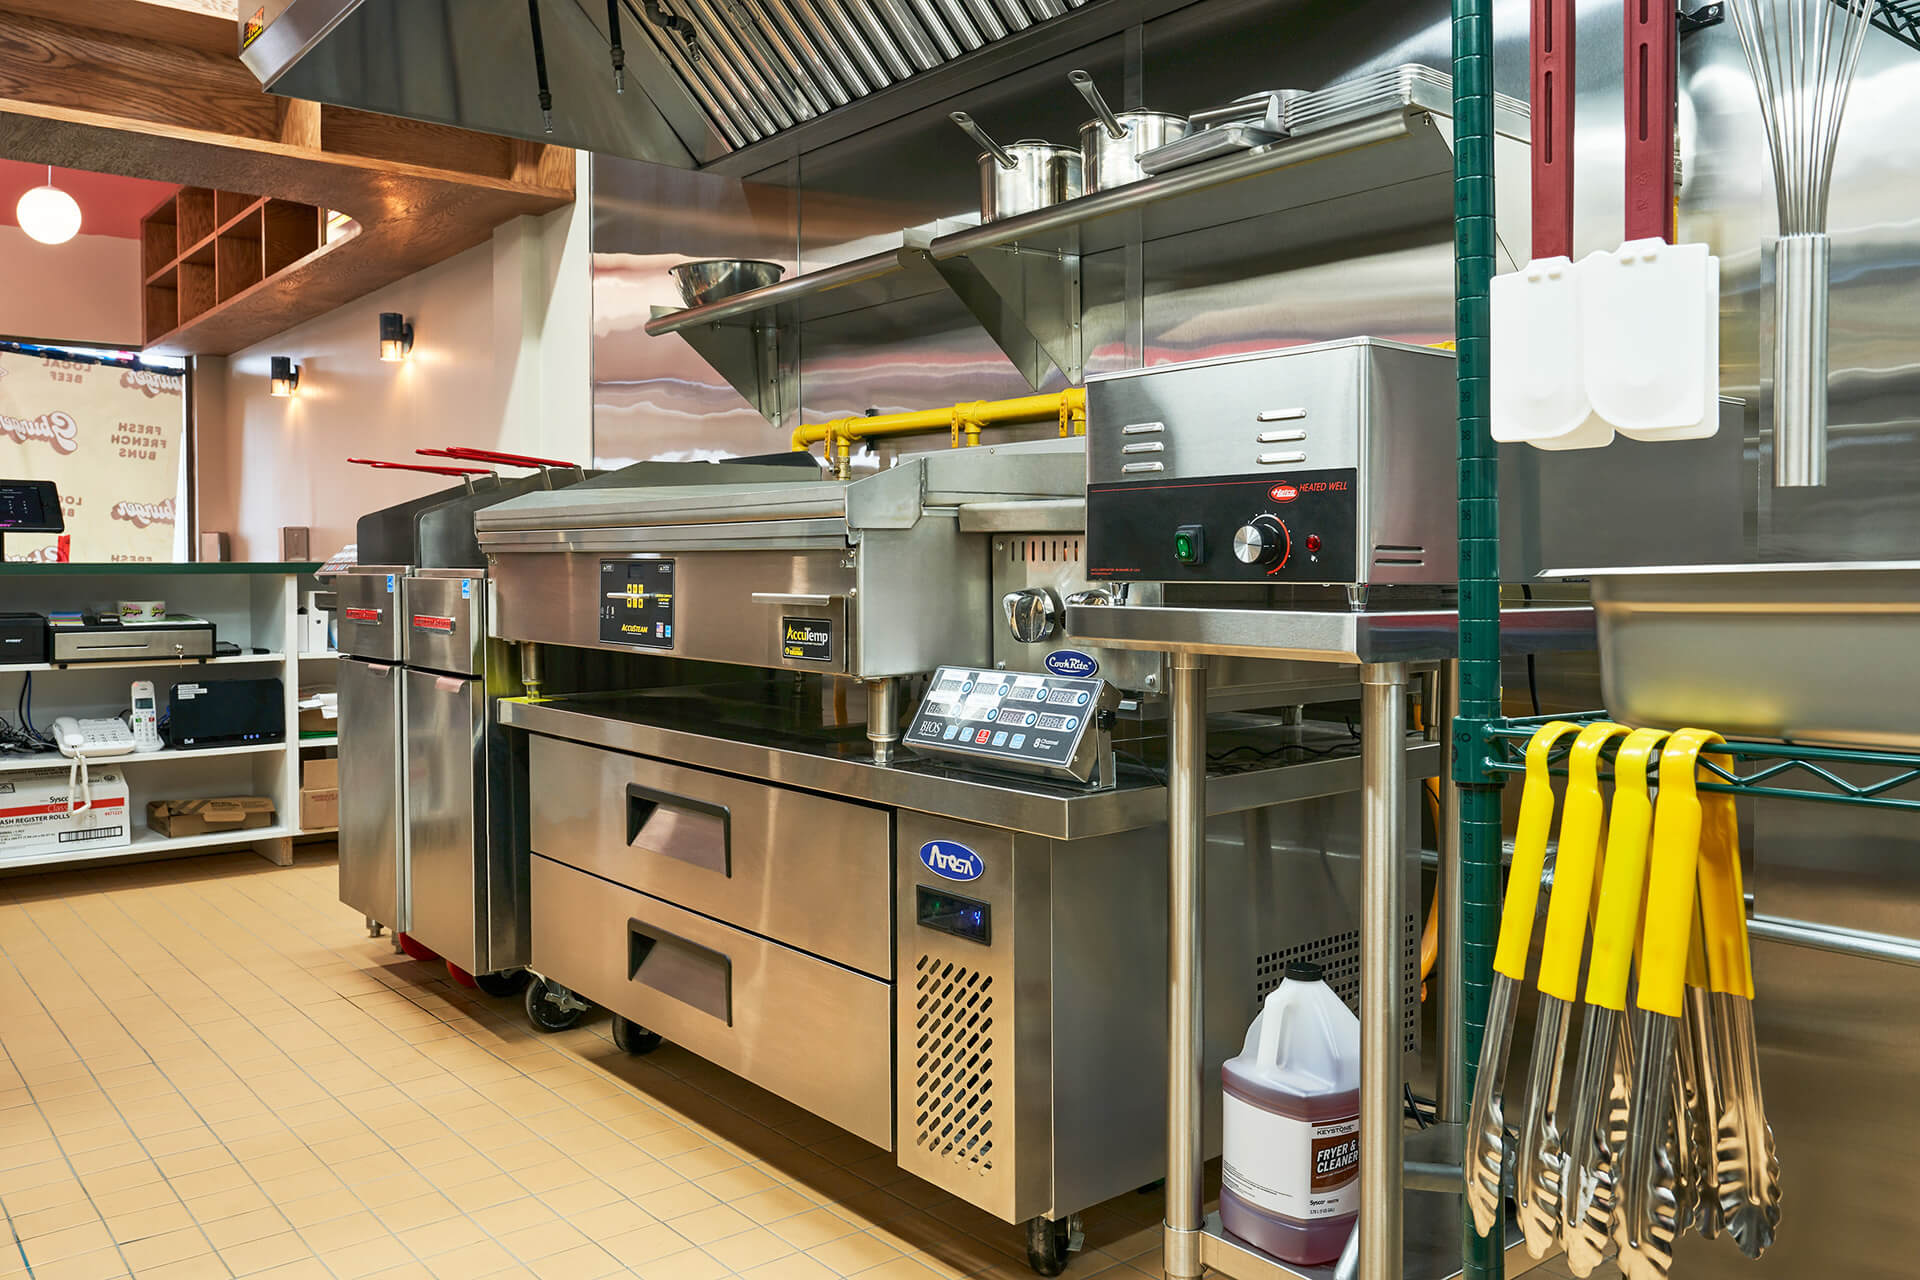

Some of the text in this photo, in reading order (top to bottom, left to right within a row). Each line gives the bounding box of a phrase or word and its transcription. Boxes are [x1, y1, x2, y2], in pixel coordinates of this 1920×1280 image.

[1299, 481, 1348, 492] HEATED WELL
[786, 624, 828, 645] AccuTemp
[920, 720, 942, 734] BIOS
[1033, 738, 1041, 748] 8
[16, 815, 48, 823] REGISTER
[1317, 1124, 1353, 1136] KEYSTONE
[1317, 1143, 1349, 1163] FRYER
[1350, 1139, 1356, 1151] &
[1317, 1150, 1359, 1174] CLEANER
